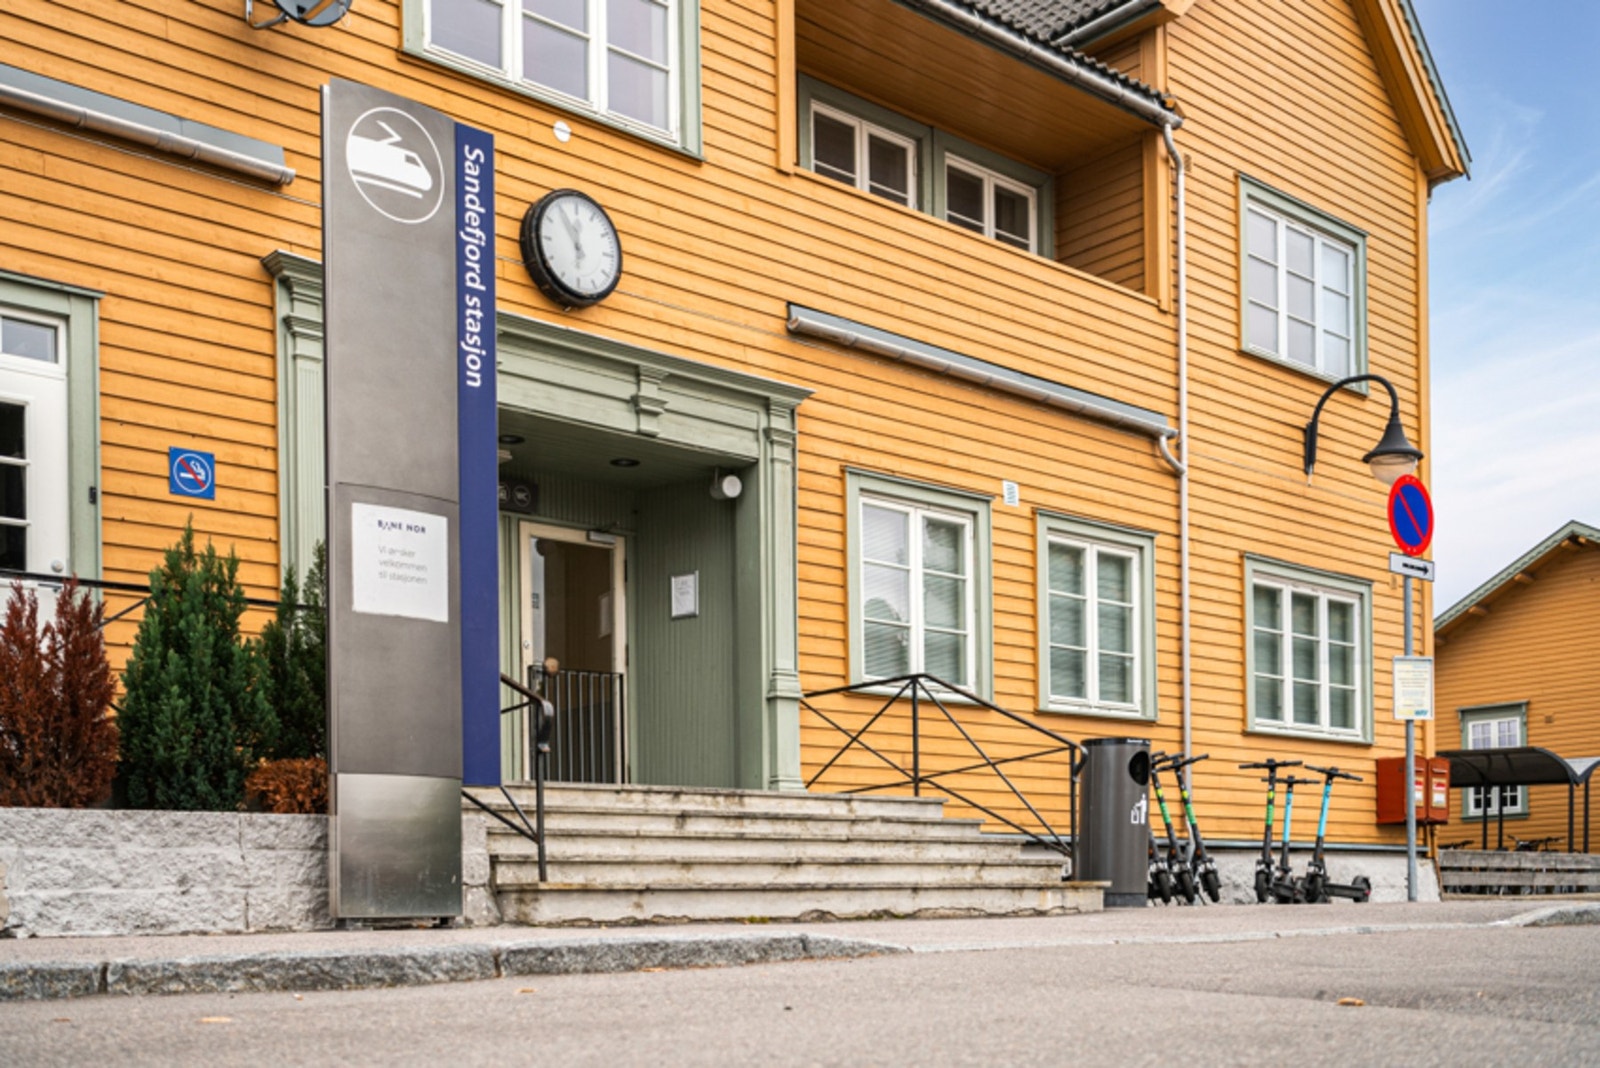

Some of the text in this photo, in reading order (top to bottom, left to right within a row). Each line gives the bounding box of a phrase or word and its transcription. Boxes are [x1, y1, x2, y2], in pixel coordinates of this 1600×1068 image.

[460, 145, 486, 388] Sandefjord stasjon
[377, 519, 426, 534] BANE NOR
